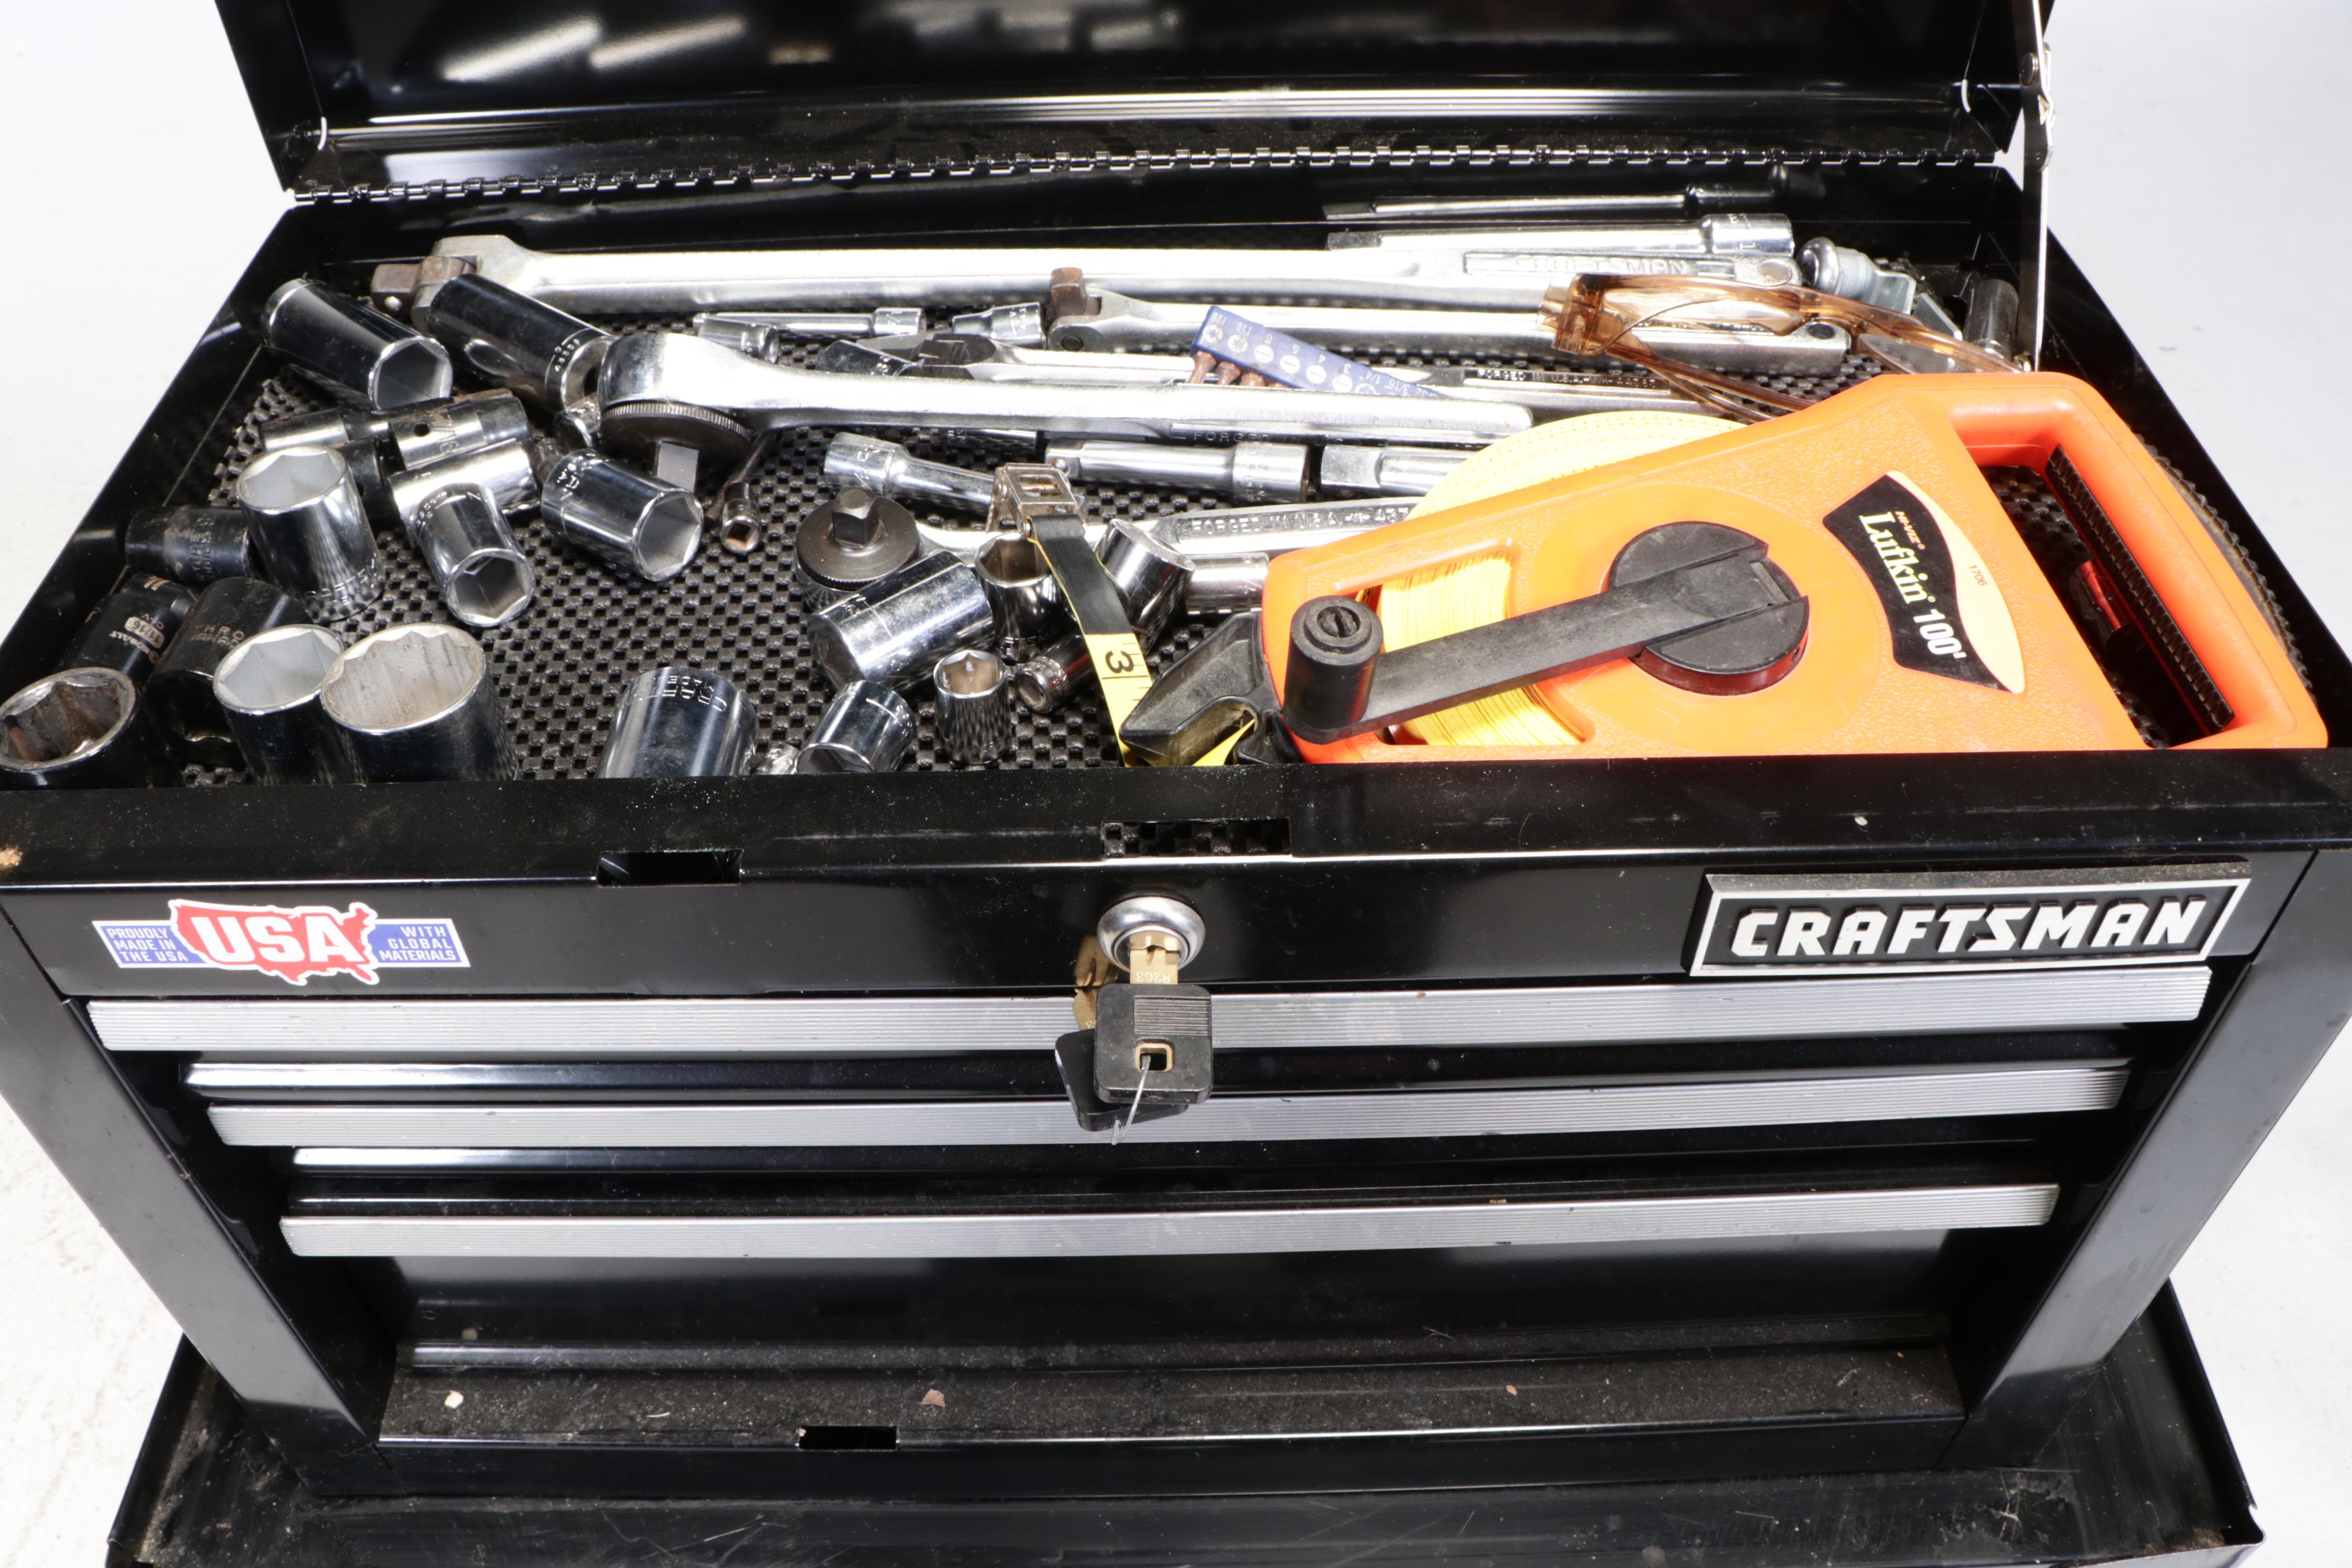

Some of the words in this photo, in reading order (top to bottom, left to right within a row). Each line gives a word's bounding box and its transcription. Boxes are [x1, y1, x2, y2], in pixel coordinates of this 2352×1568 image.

[1515, 254, 1685, 275] CRAFTSMAN
[1318, 354, 1326, 363] 4
[1344, 364, 1351, 374] 3
[1191, 517, 1263, 534] FORGED
[1858, 511, 1929, 604] Lufkin
[1969, 565, 1988, 586] 1706
[132, 620, 161, 643] 11/16
[1104, 650, 1134, 674] 3
[106, 927, 169, 939] PROUDLY
[400, 926, 446, 937] WITH
[1731, 898, 2207, 957] CRAFTSMAN
[113, 939, 158, 950] MADE
[158, 939, 177, 950] IN
[190, 916, 365, 963] USA
[387, 938, 453, 949] GLOBAL
[119, 951, 152, 962] THE
[154, 951, 188, 962] USA
[378, 950, 456, 961] MATERIALS
[1135, 971, 1172, 984] 8203
